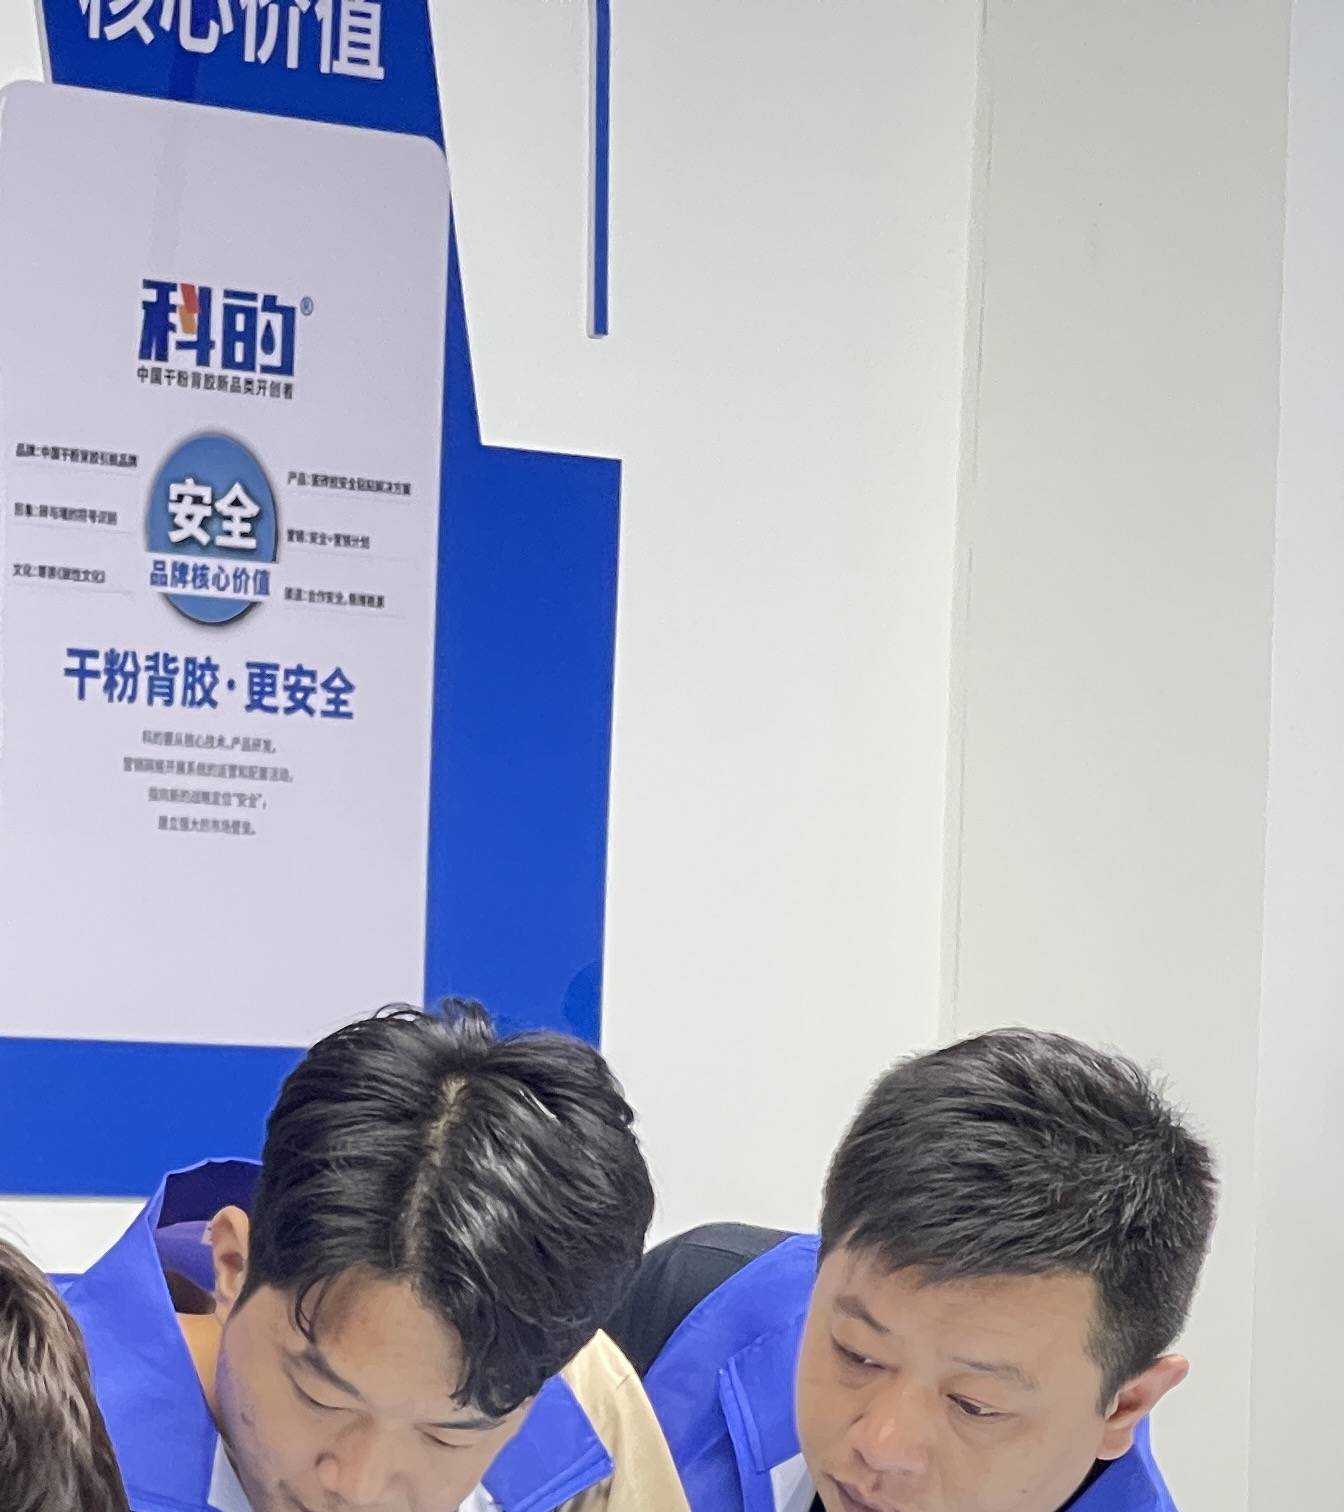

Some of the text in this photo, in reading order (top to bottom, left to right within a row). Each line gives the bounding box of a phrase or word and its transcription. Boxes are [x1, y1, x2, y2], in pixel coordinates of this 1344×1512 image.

[137, 365, 294, 400] 中国干粉背胶新品类开创者
[167, 477, 262, 551] 安全
[149, 559, 271, 597] 品牌核心价值
[64, 648, 356, 720] 干粉背胶·更安全
